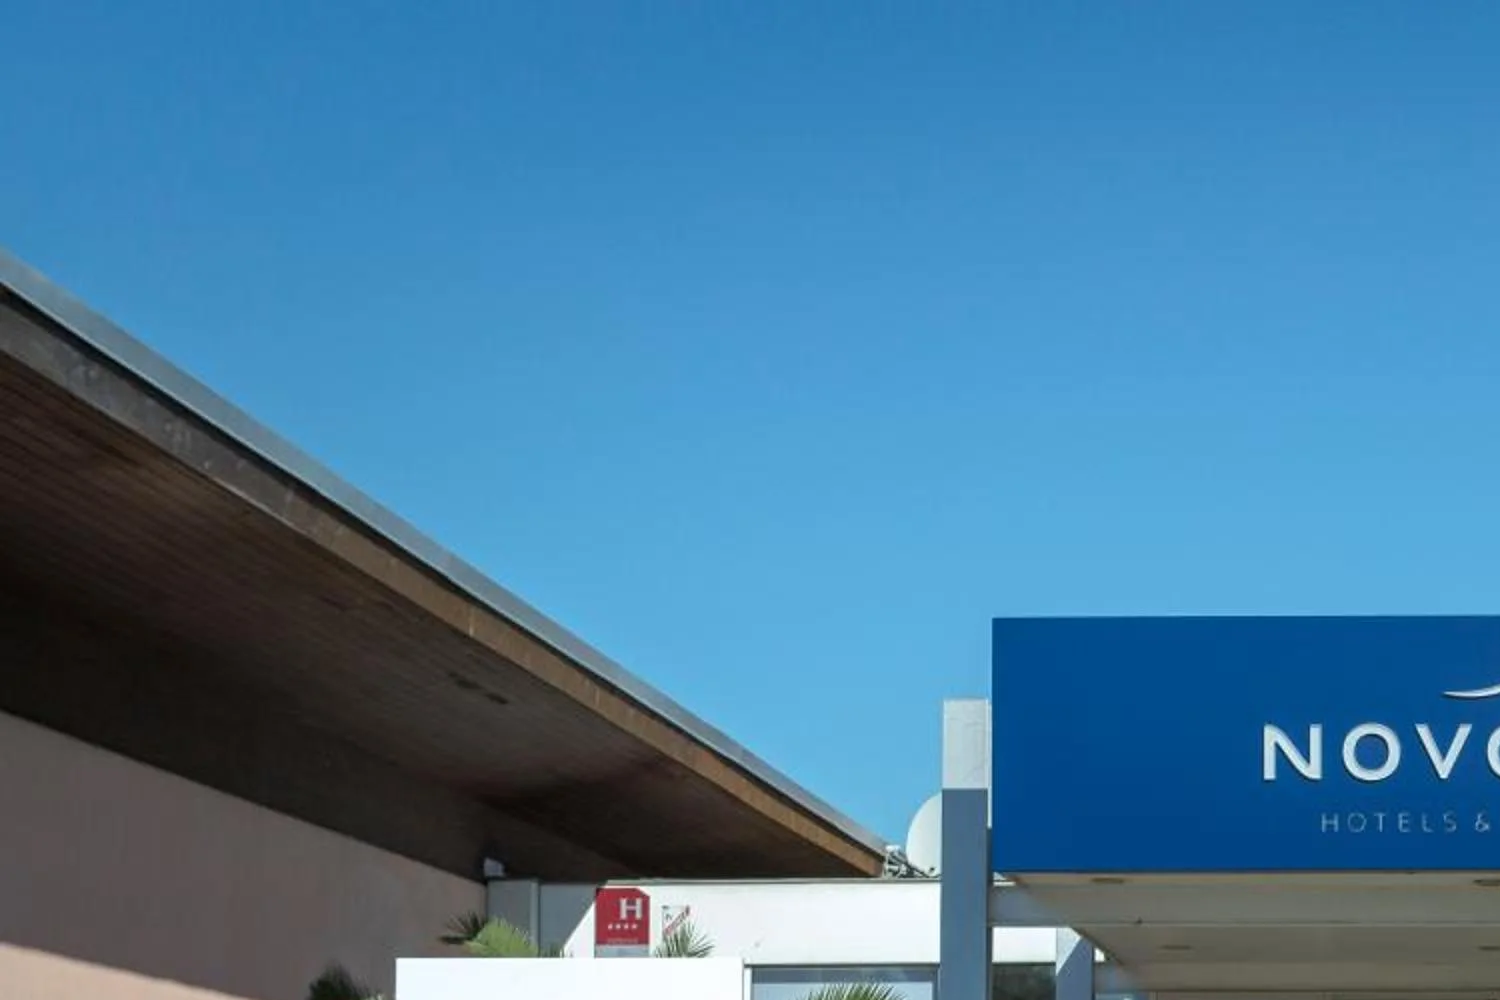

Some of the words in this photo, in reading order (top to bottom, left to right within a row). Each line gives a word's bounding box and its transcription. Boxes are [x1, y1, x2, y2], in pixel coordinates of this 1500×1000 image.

[1320, 810, 1458, 834] HOTELS
[1474, 811, 1491, 833] &
[620, 897, 643, 920] H
